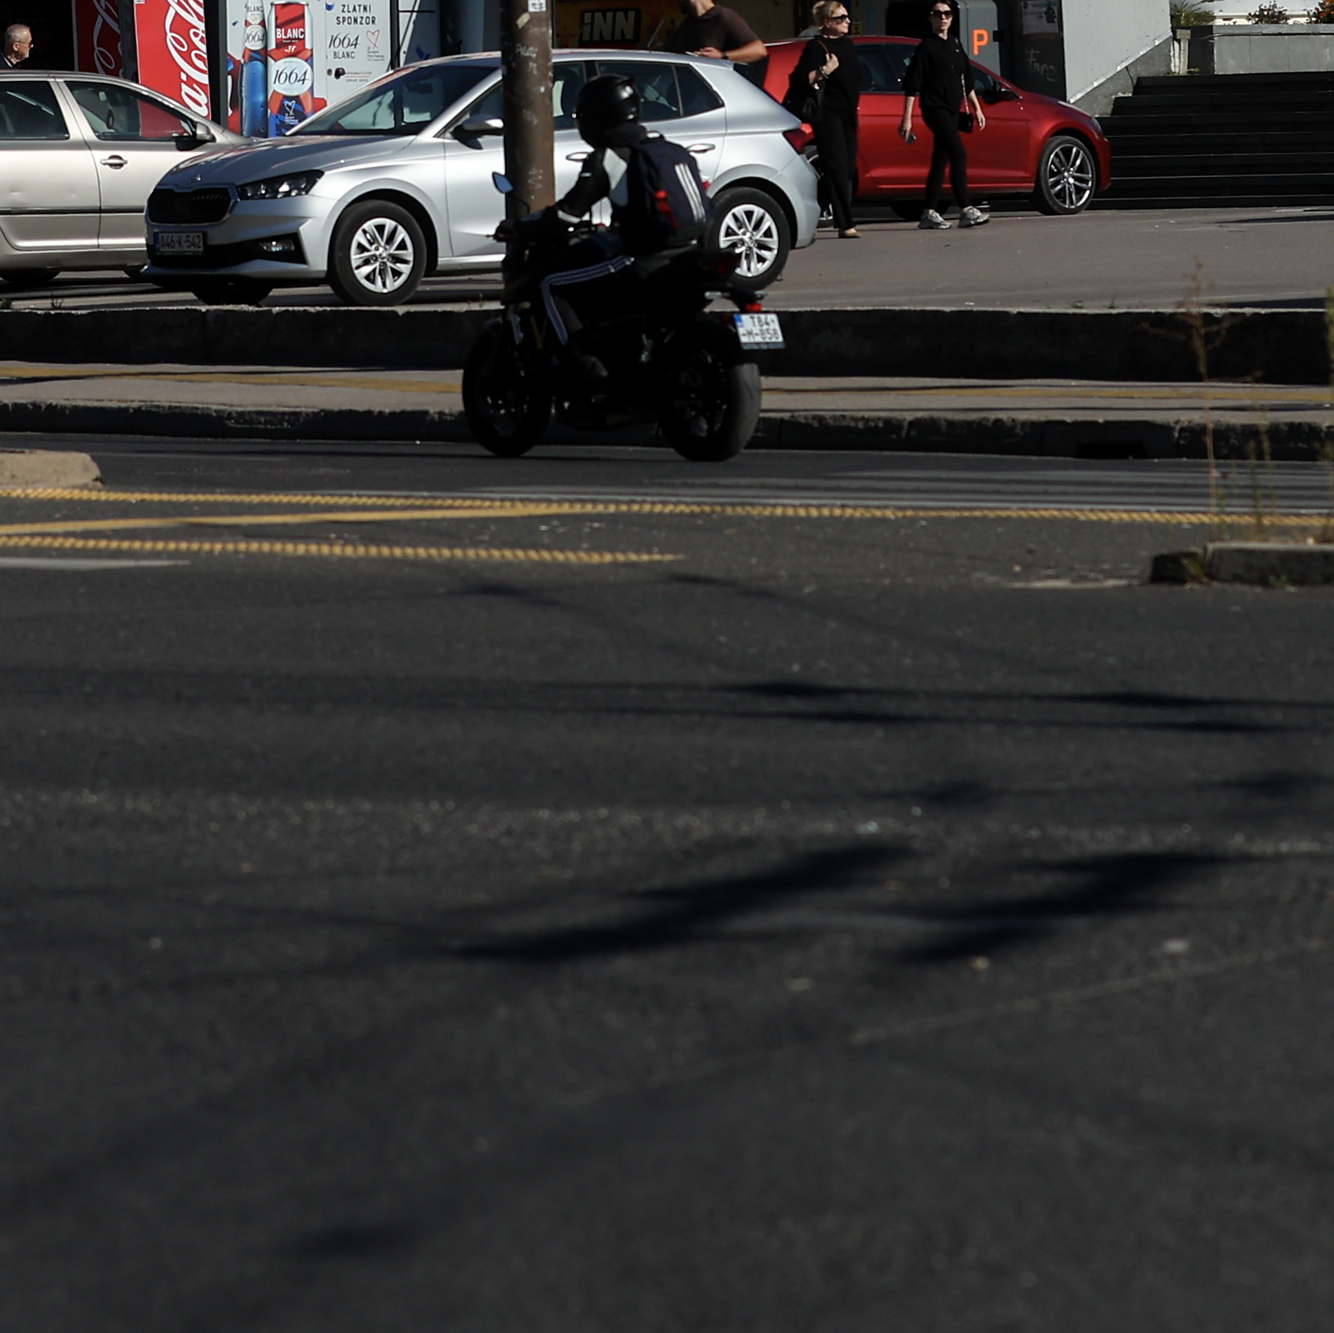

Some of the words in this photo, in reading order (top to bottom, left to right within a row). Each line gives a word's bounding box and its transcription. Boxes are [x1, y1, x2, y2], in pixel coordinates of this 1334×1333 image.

[341, 4, 371, 13] ZLATNI
[336, 16, 376, 25] SPONZOR
[276, 28, 304, 39] BLANC
[328, 33, 359, 49] 1664
[972, 29, 990, 55] P
[333, 51, 355, 60] BLANC
[272, 66, 311, 85] 1664
